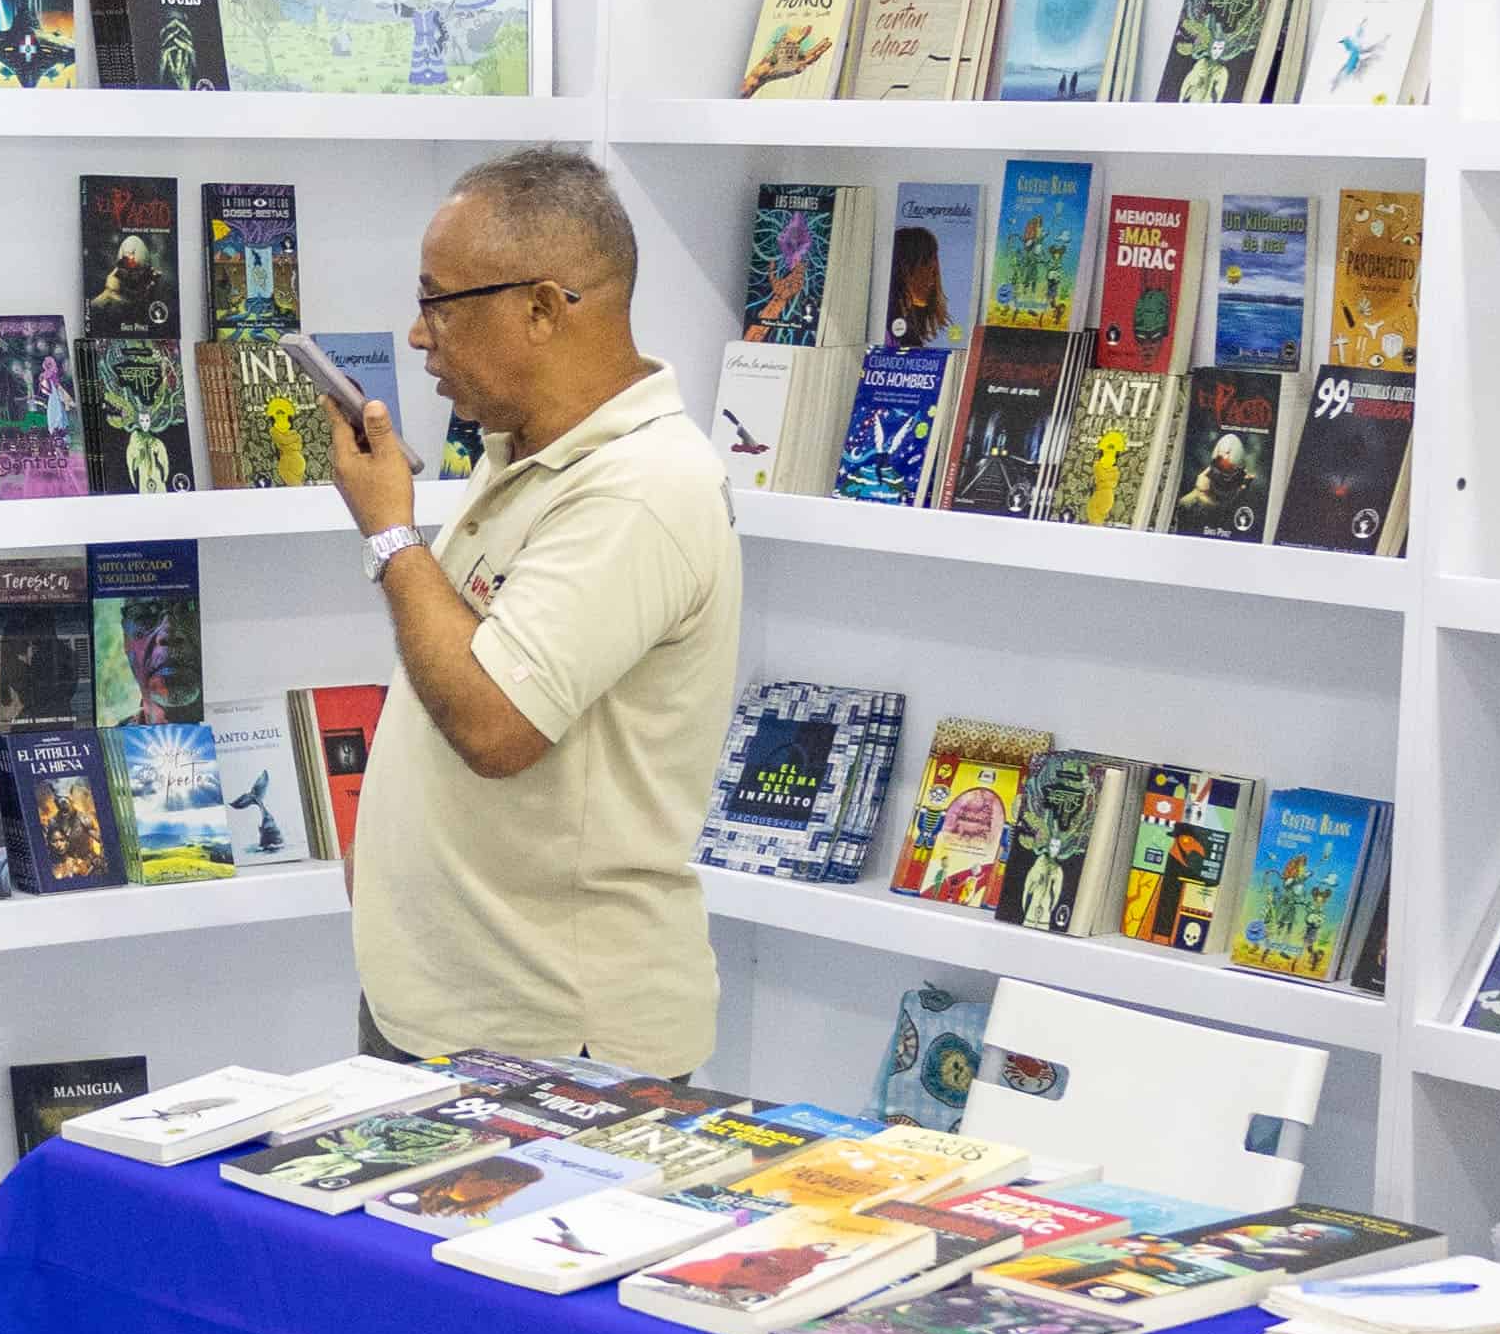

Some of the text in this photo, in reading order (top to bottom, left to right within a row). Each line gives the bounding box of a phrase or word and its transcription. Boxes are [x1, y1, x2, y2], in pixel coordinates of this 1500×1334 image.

[1114, 208, 1181, 228] MEMORIAS
[1124, 226, 1161, 246] MAR
[1117, 245, 1177, 272] DIRAC
[863, 370, 936, 391] LOS HOMBRES
[1088, 376, 1161, 418] INTI
[1314, 377, 1351, 420] 99
[252, 727, 282, 741] AZUL
[16, 747, 30, 761] EL
[30, 744, 80, 761] PITBULL
[779, 763, 797, 775] EL
[757, 772, 817, 787] ENIGMA
[762, 782, 791, 795] DEL
[738, 789, 811, 807] INFINITO
[53, 1081, 123, 1099] MANIGUA
